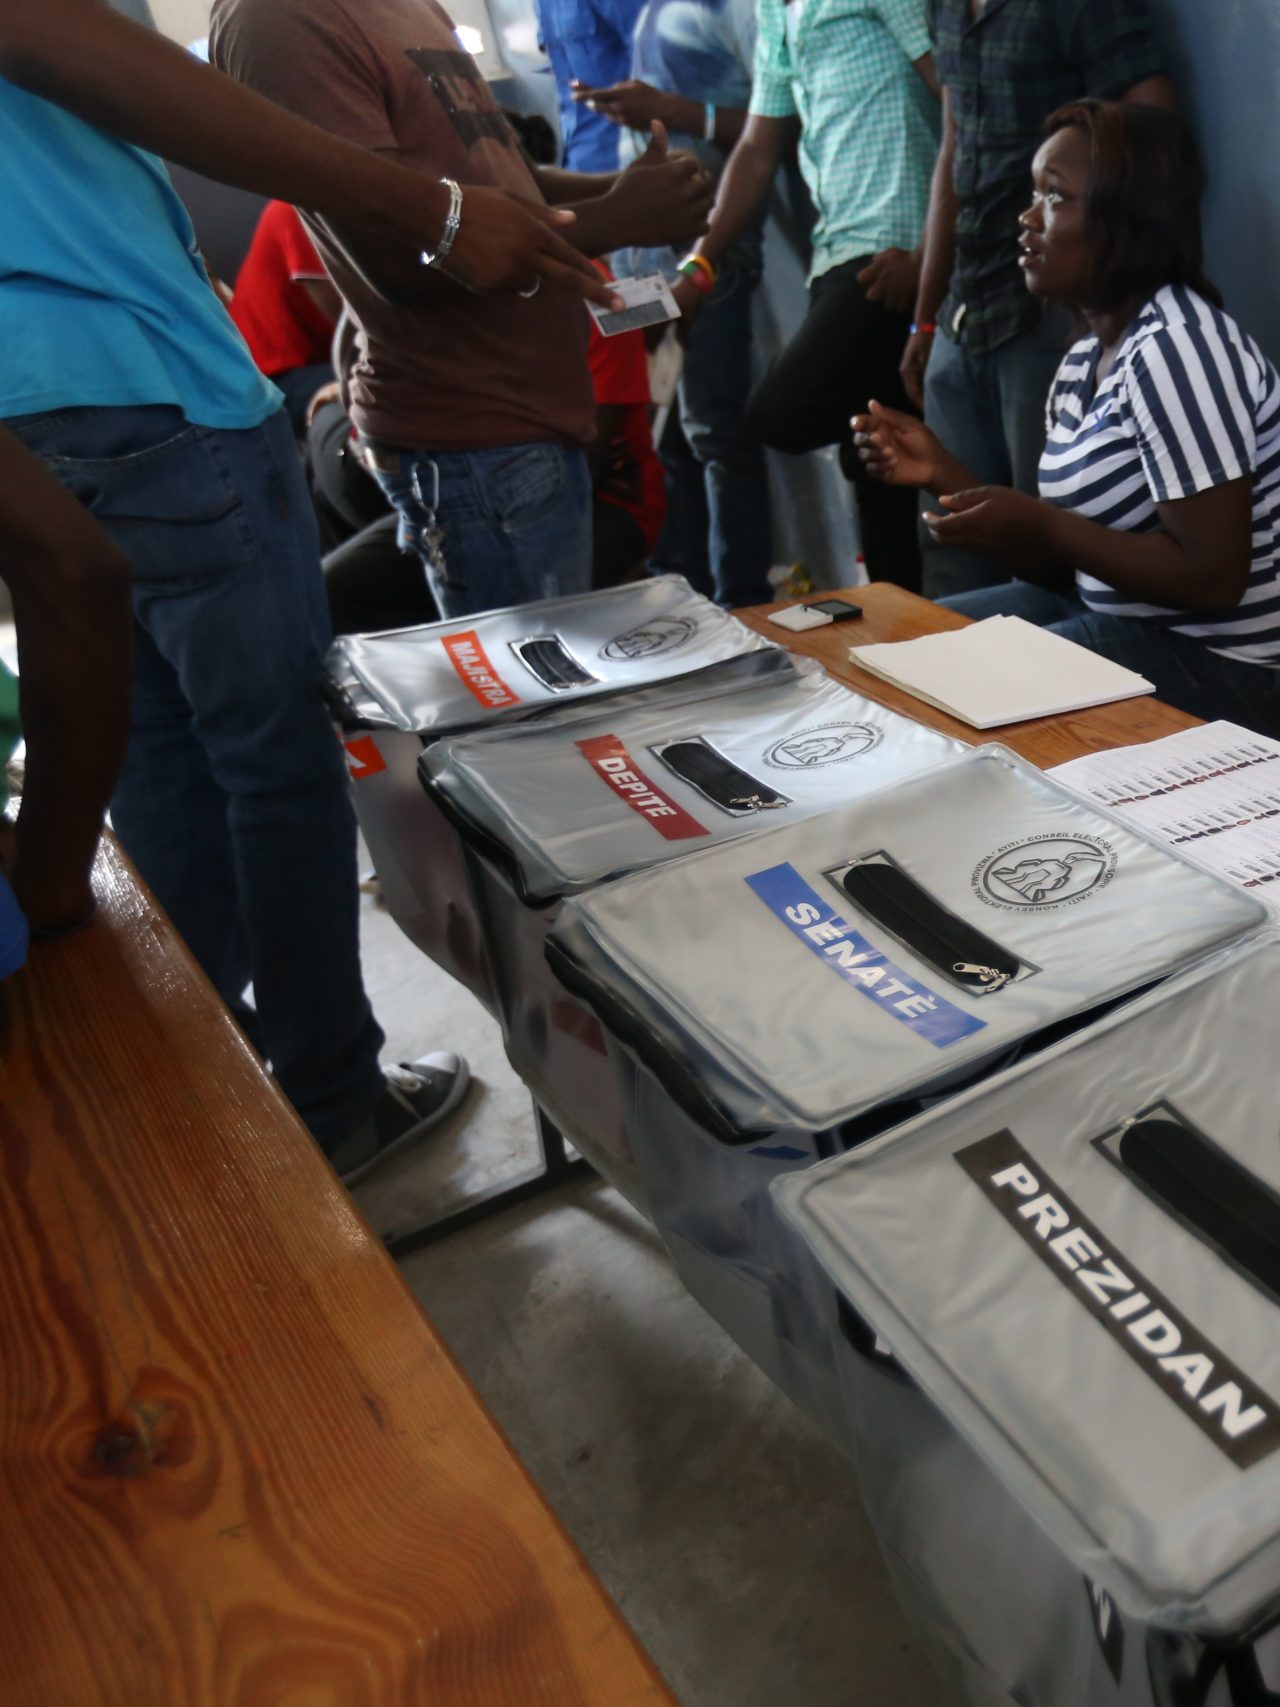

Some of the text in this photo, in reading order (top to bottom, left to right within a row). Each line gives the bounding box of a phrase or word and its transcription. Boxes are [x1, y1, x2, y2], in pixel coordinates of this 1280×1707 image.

[597, 757, 678, 817] DEPITE
[997, 841, 1020, 853] AYITI
[1027, 832, 1071, 842] CONSEIL
[990, 1162, 1267, 1437] PREZIDAN
